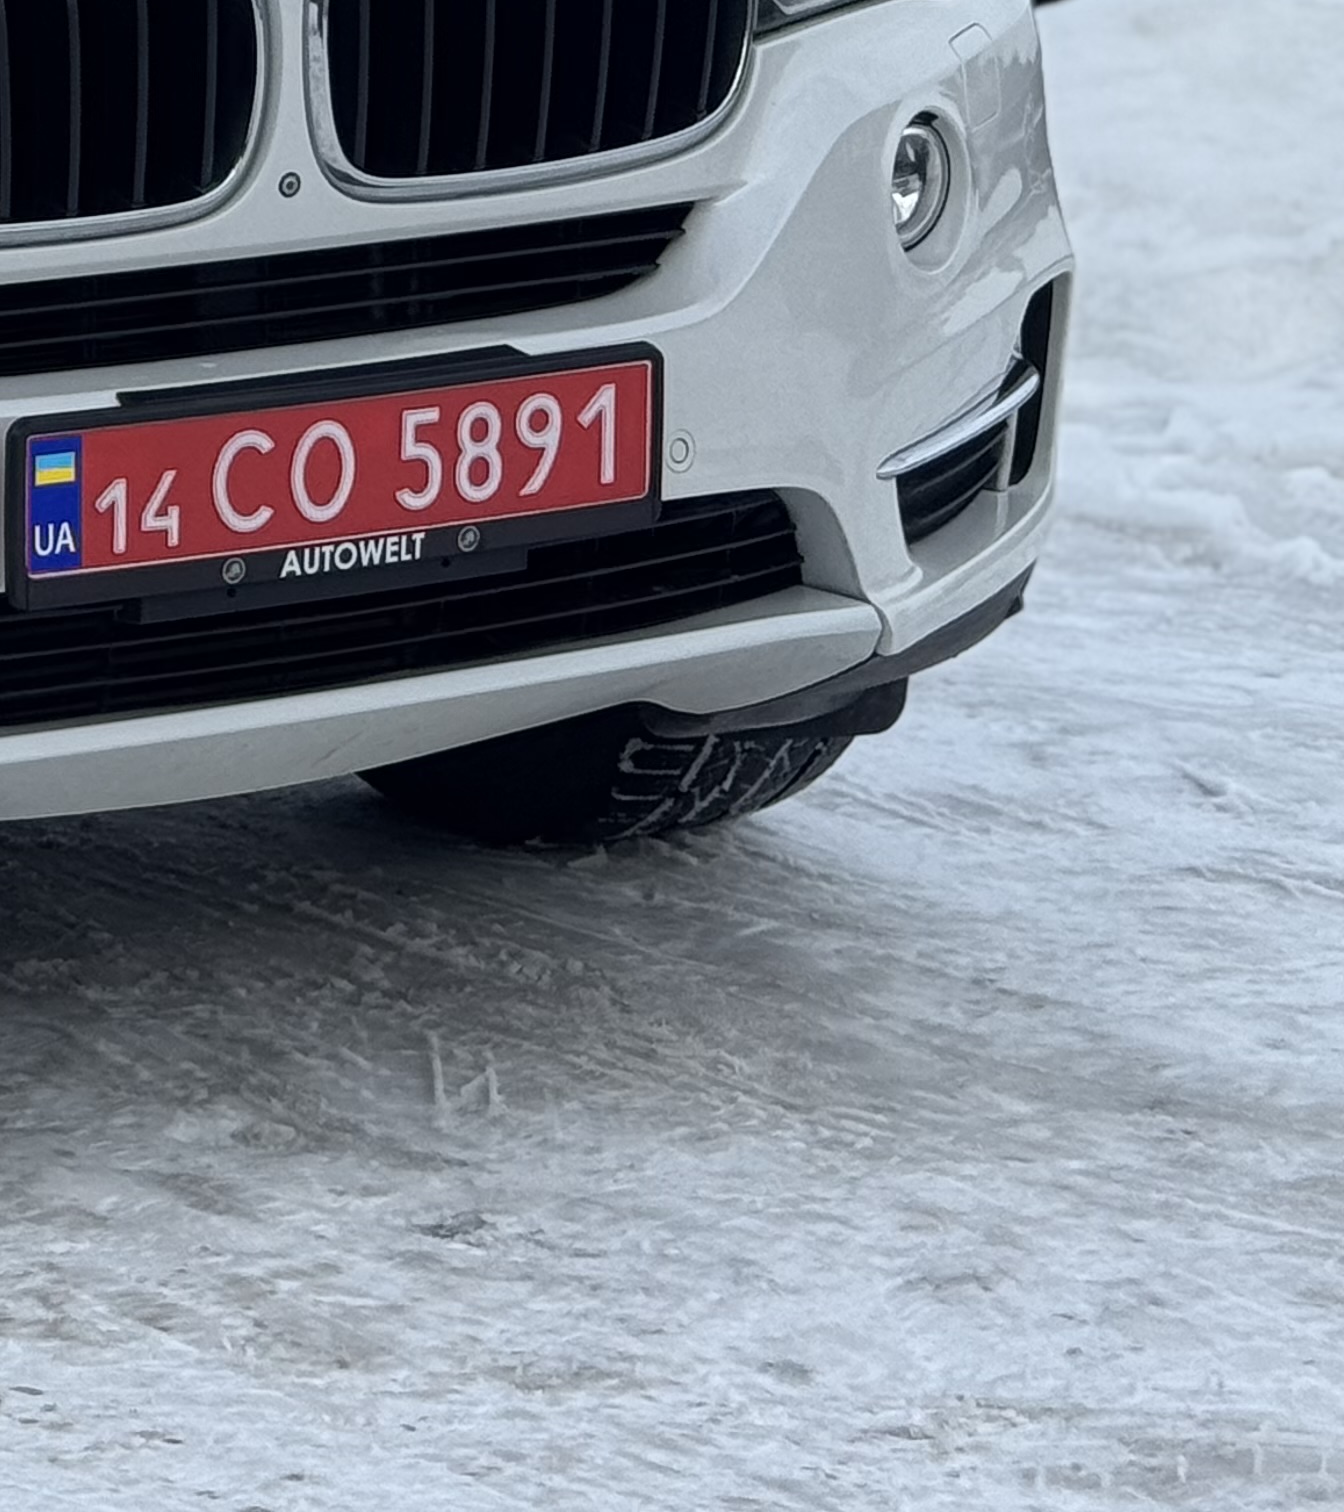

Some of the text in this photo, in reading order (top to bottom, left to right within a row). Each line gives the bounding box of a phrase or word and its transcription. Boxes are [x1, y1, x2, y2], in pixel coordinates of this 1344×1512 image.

[95, 383, 616, 555] 14 CO 5891
[34, 520, 76, 557] UA
[279, 532, 426, 579] AUTOWELT
